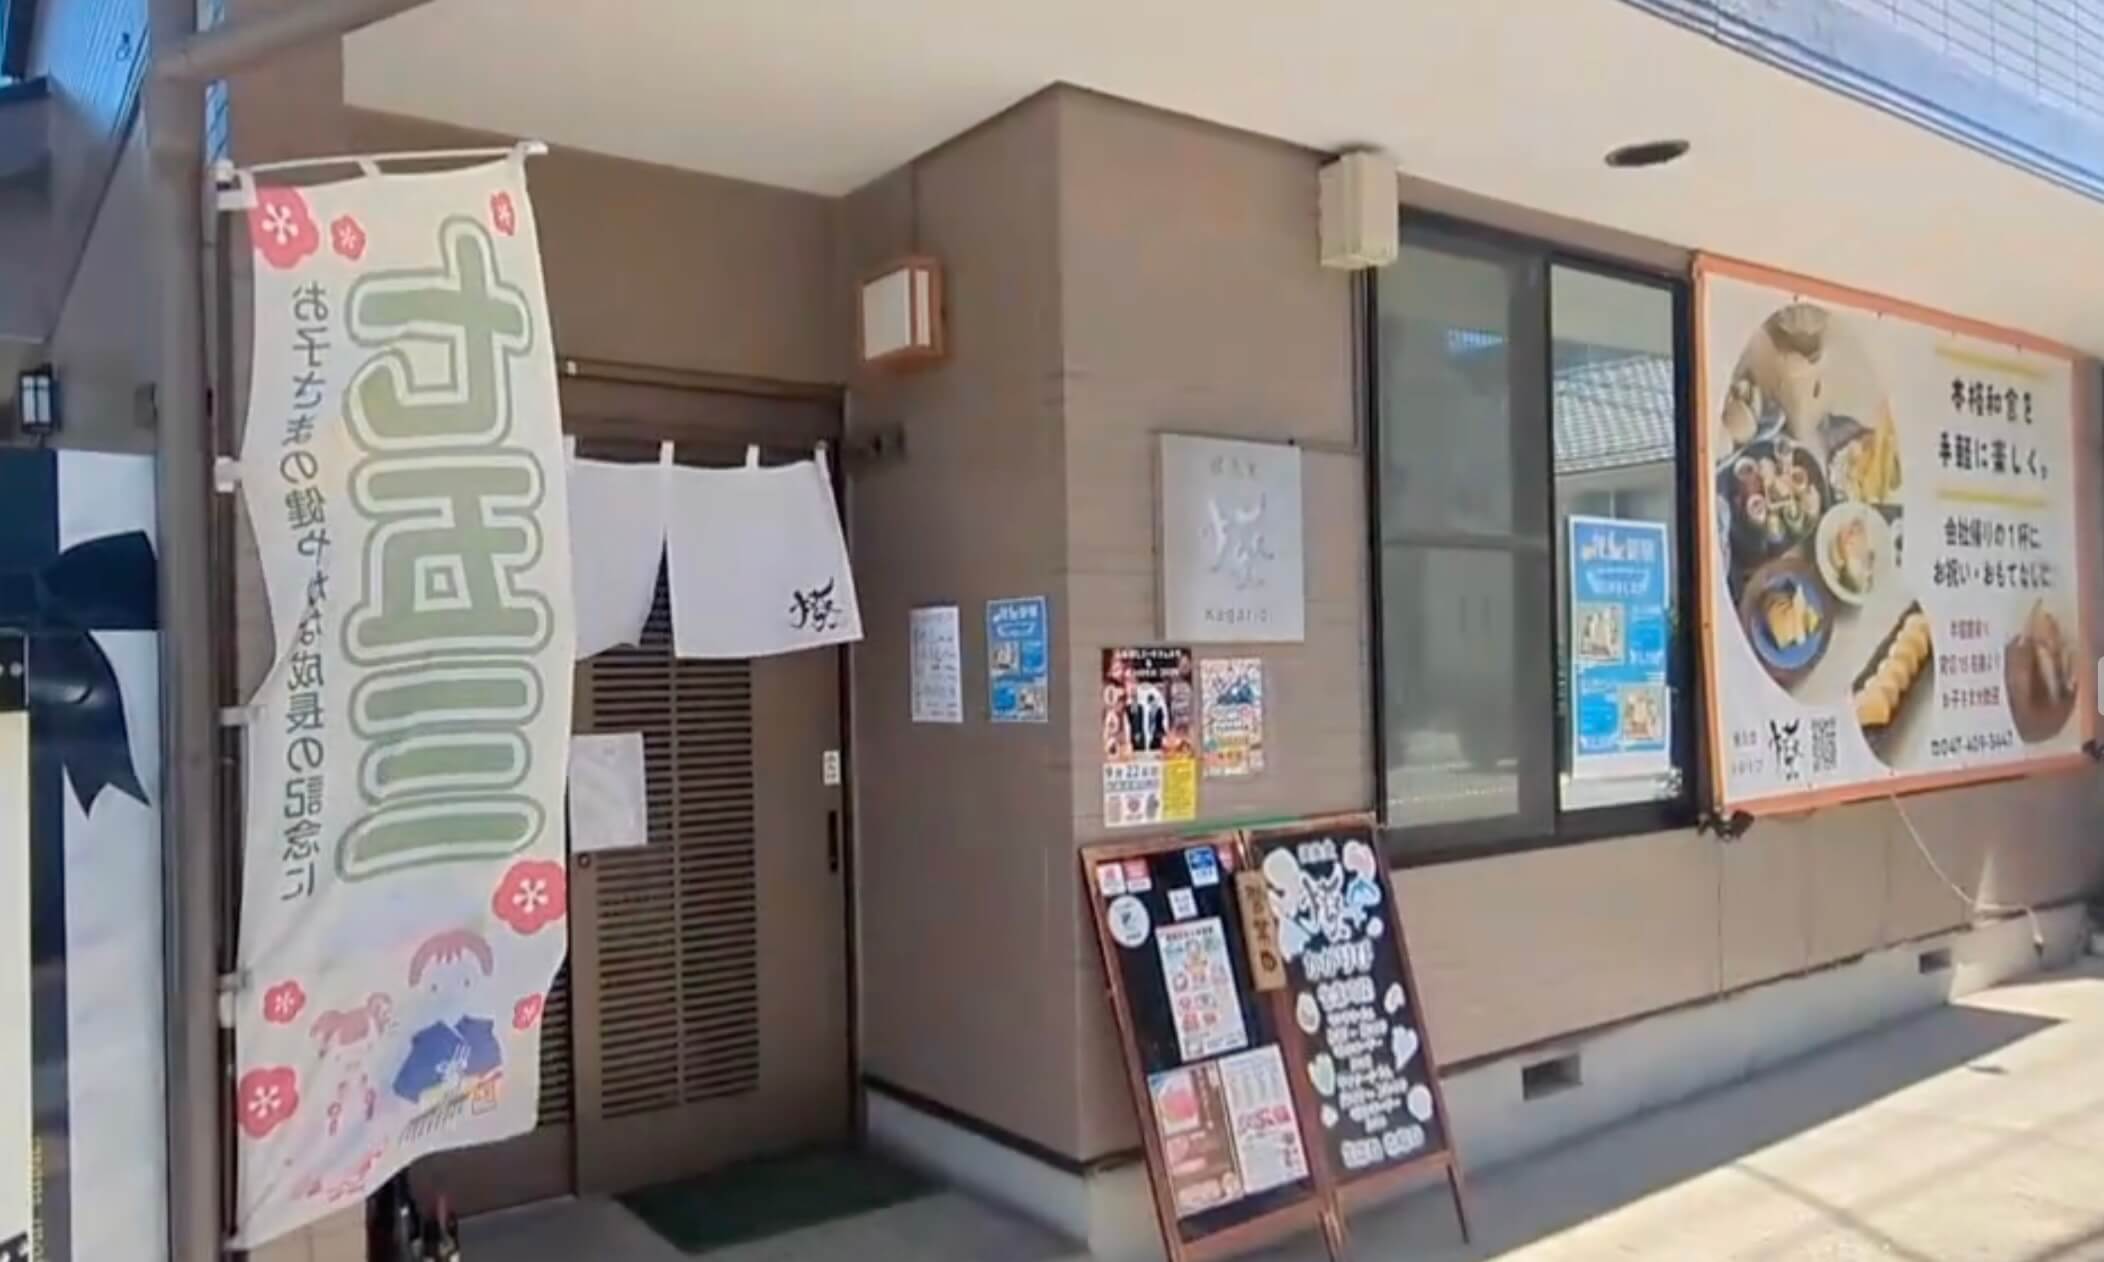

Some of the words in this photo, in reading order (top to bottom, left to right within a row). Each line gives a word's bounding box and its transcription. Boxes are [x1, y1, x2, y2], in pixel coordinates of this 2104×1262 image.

[1951, 377, 2034, 424] 本格和食を
[1938, 431, 2048, 480] 手軽に楽しく。
